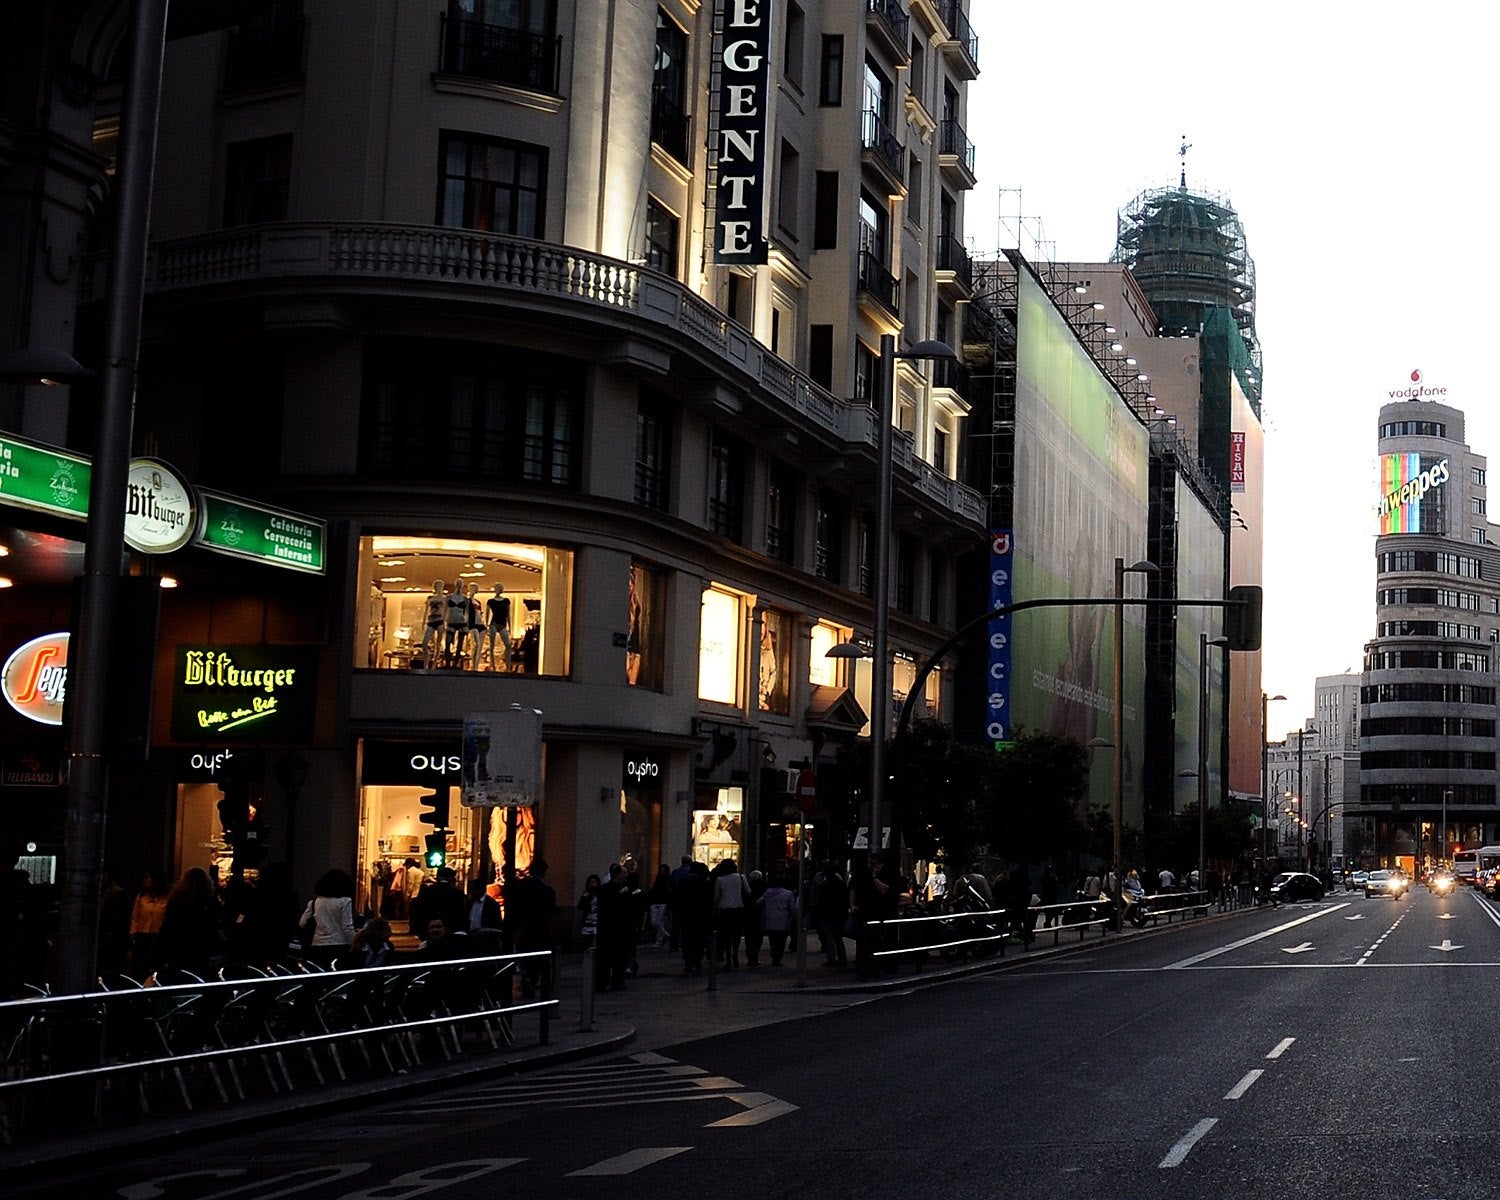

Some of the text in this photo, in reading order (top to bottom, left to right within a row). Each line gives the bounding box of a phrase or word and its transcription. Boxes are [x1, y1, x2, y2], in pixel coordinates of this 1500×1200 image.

[719, 0, 763, 254] EGENTE
[1388, 385, 1447, 399] vodafone
[1232, 434, 1244, 481] HISAN
[126, 482, 185, 529] Bitburger
[263, 528, 313, 550] Cerveceria
[270, 516, 313, 538] Cafeteria
[274, 543, 313, 563] Internet
[986, 533, 1010, 740] detecsa
[184, 650, 296, 692] Bitburger
[627, 755, 659, 782] oysho
